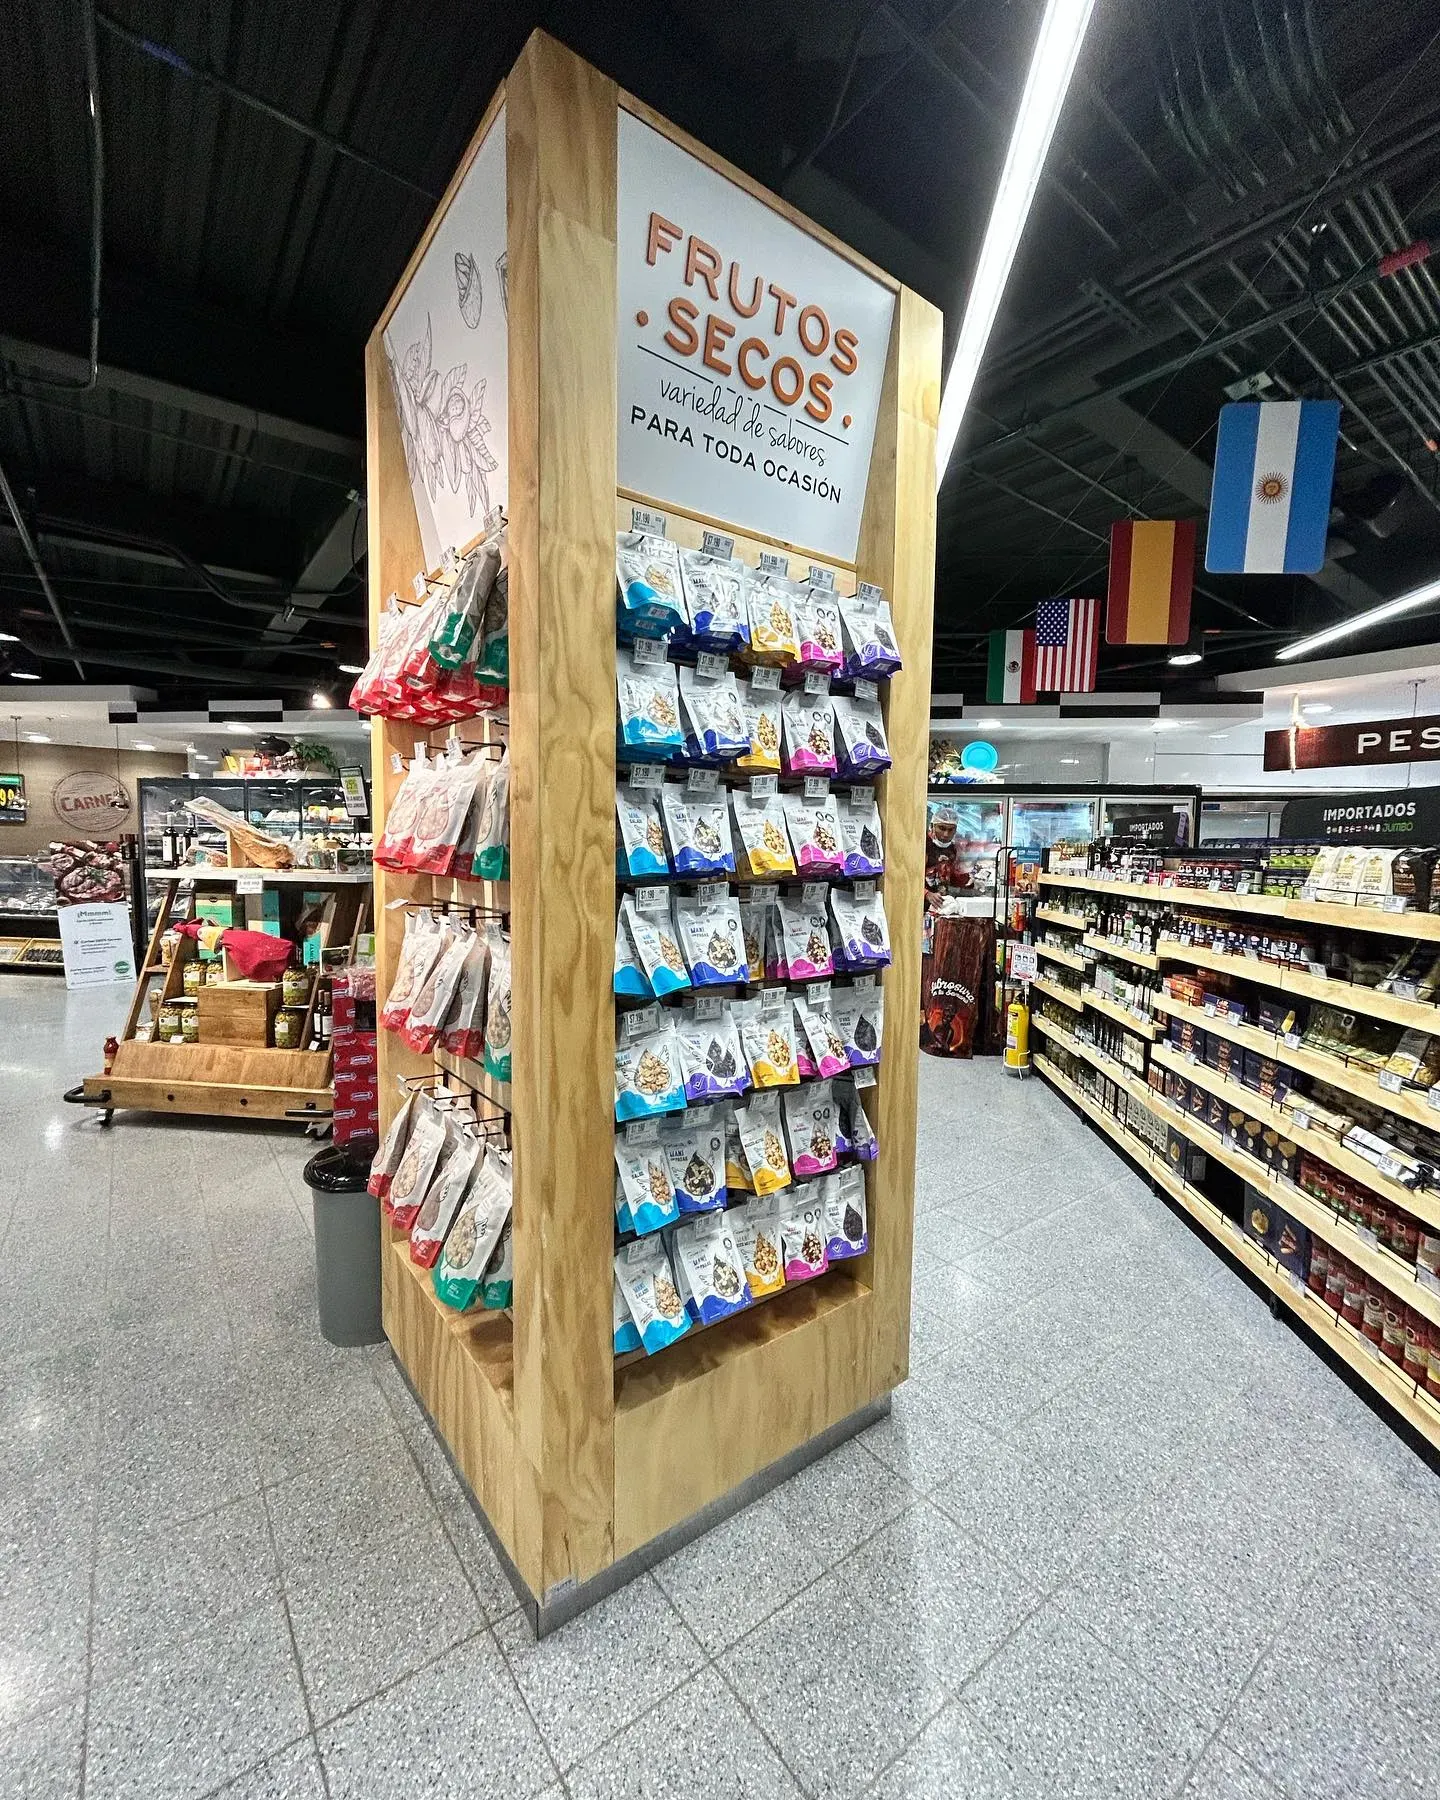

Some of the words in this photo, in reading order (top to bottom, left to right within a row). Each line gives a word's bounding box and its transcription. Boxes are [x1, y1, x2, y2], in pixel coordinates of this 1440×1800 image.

[646, 212, 859, 375] FRUTOS
[631, 405, 694, 447] PARA
[703, 434, 757, 472] TODA
[763, 459, 842, 504] OCASIÓN
[661, 379, 740, 432] variedad
[743, 403, 765, 439] de
[769, 417, 827, 467] sabores
[1129, 821, 1164, 832] IMPORTADOS
[1323, 802, 1417, 821] IMPORTADOS
